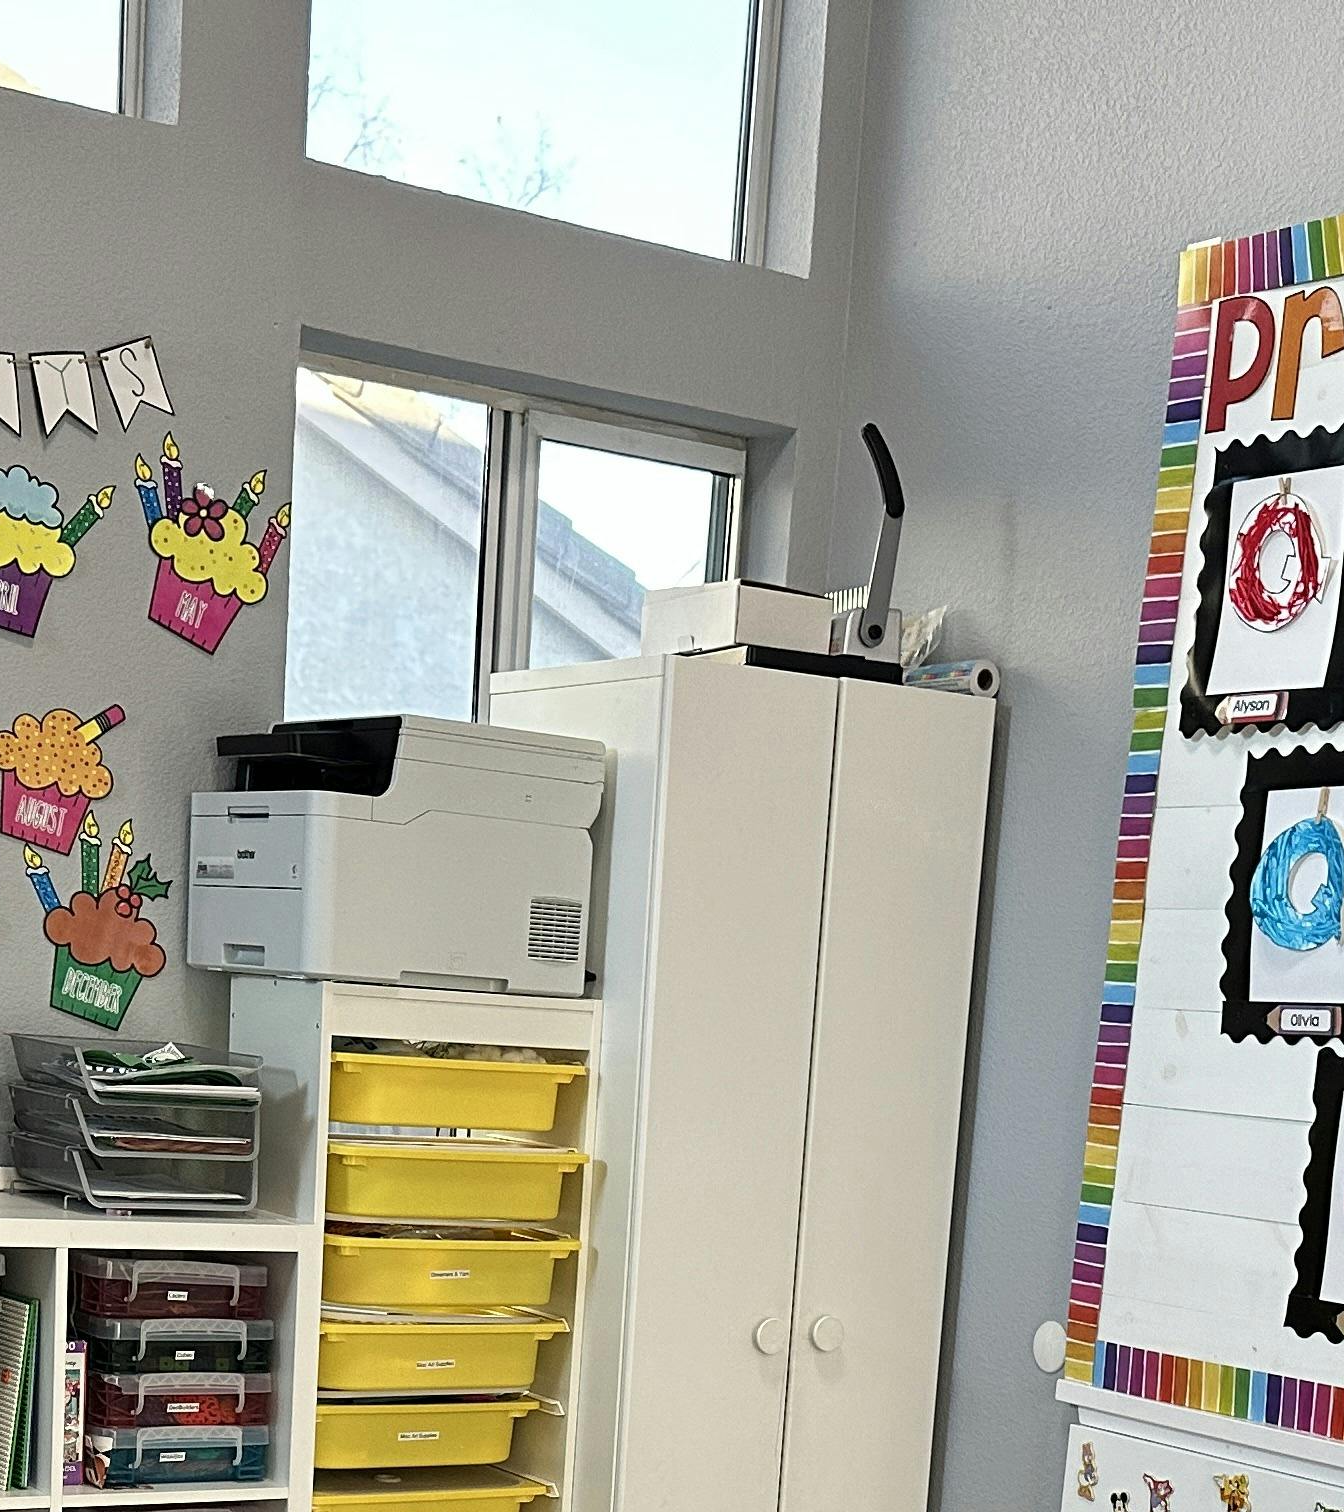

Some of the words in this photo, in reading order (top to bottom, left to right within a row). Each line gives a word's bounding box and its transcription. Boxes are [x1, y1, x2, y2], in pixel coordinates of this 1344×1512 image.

[175, 596, 207, 626] MAY
[1233, 699, 1269, 712] Alyson
[16, 795, 65, 837] AUGUST
[63, 968, 122, 1012] DECEMBER
[1290, 1013, 1319, 1027] Olivia
